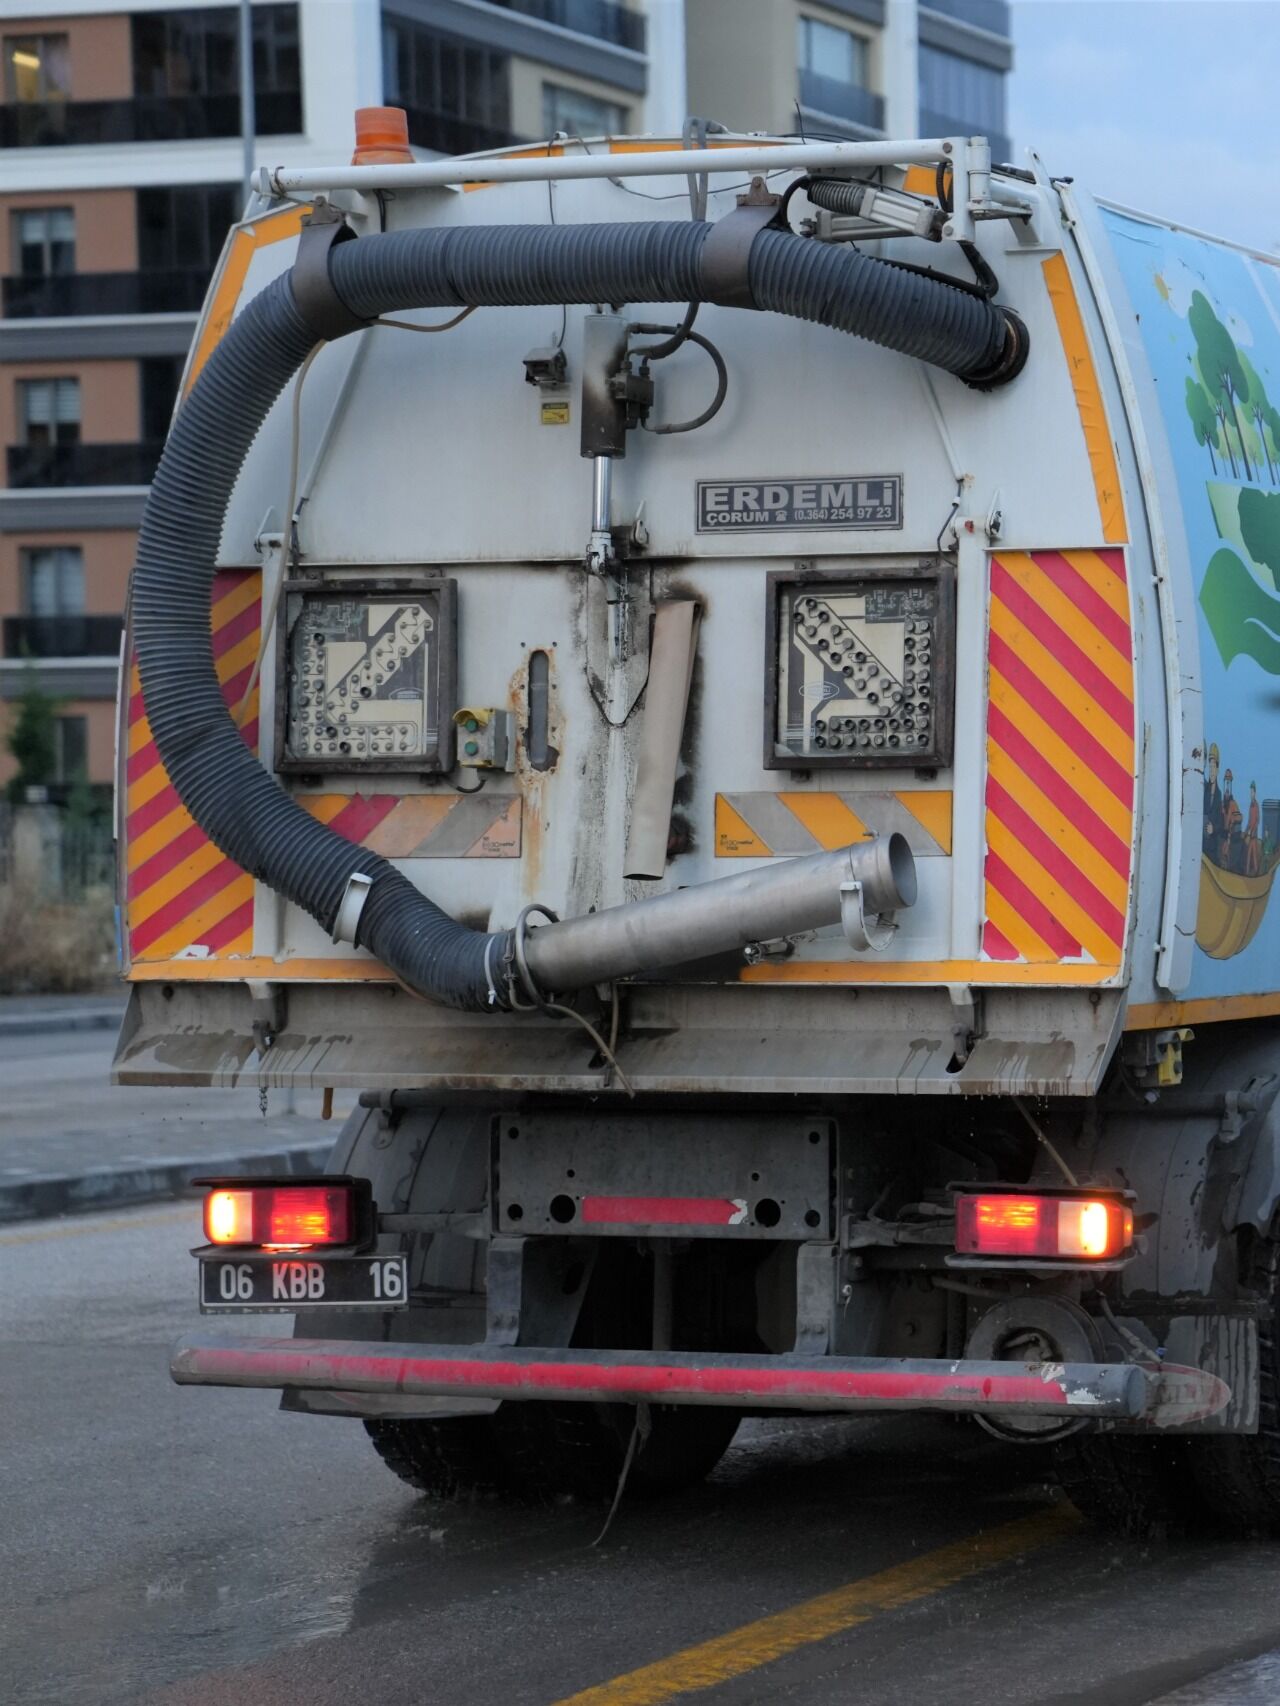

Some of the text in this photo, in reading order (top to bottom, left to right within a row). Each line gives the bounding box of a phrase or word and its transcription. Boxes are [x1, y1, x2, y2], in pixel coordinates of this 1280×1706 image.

[706, 506, 892, 526] ÇORUM (0.364) 254 97 23
[219, 1261, 401, 1299] 06 KBB 16
